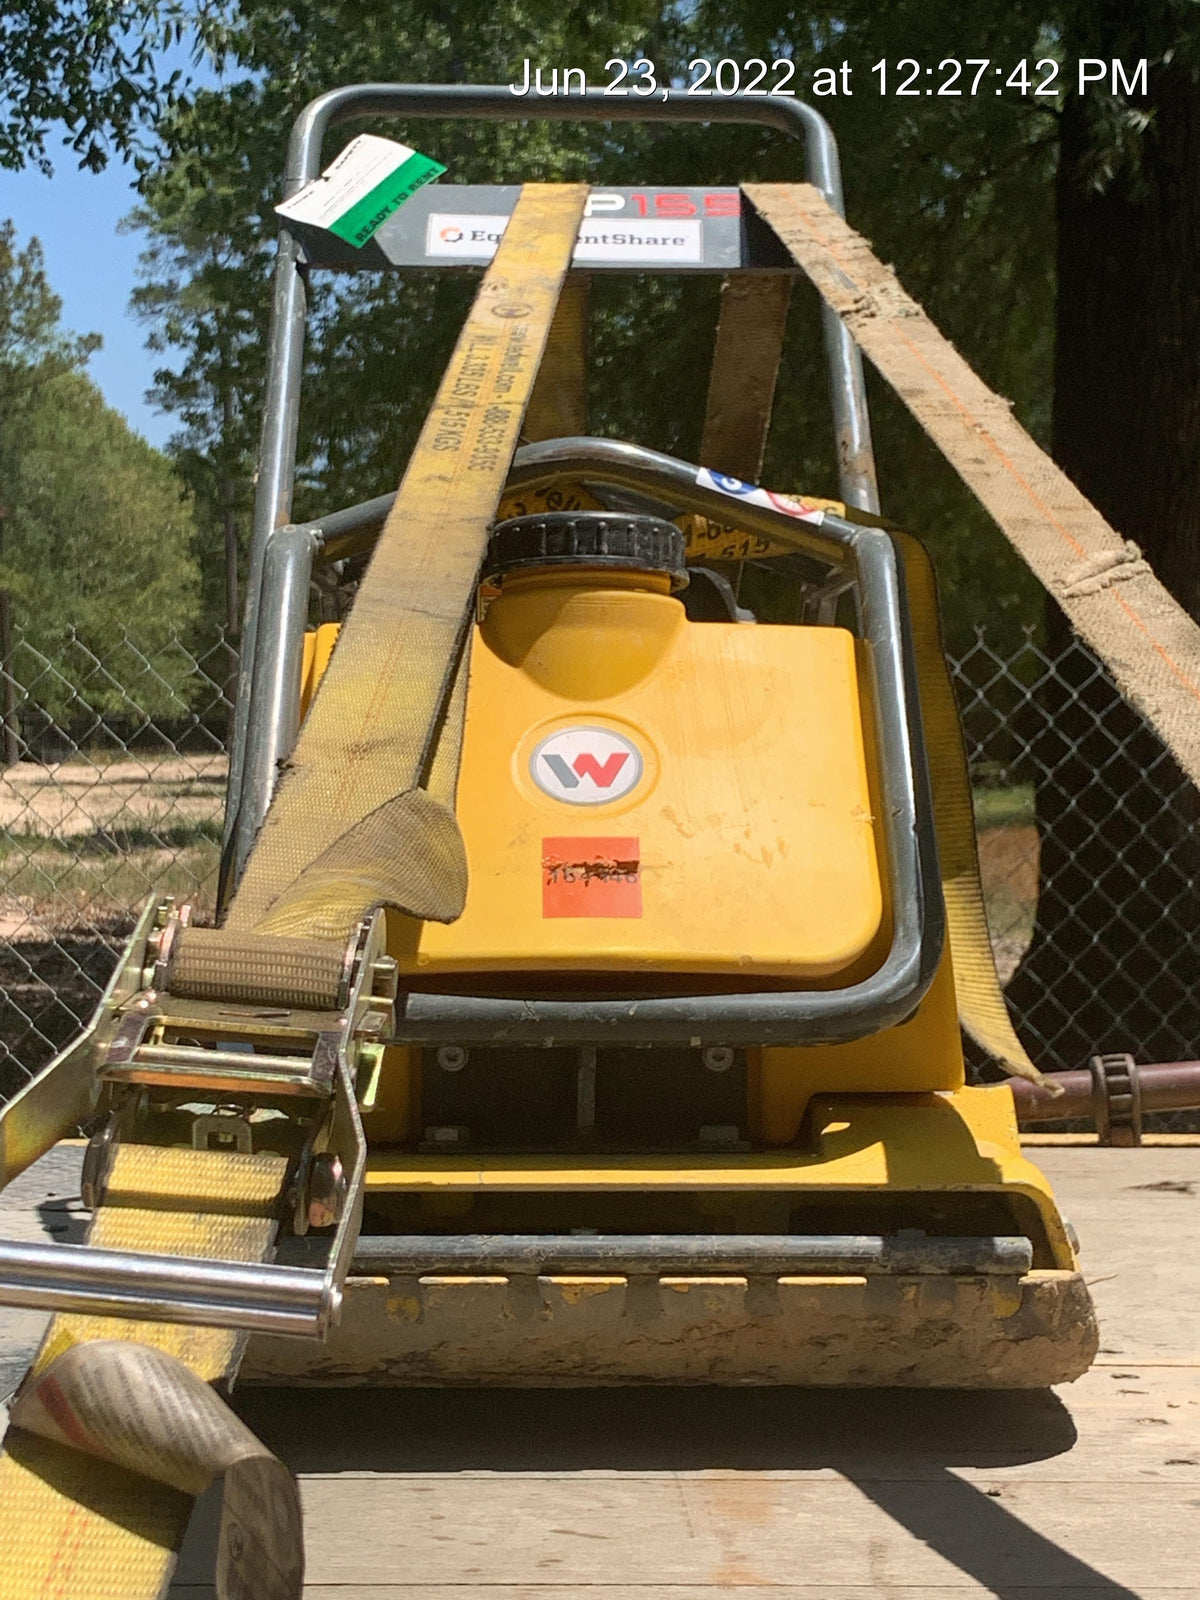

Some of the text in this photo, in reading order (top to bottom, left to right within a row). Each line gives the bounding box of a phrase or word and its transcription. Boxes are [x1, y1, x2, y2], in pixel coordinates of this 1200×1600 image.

[355, 167, 440, 243] READY TO RENT
[470, 230, 686, 247] EqentShare
[452, 377, 482, 397] LBS
[433, 428, 464, 452] KGS
